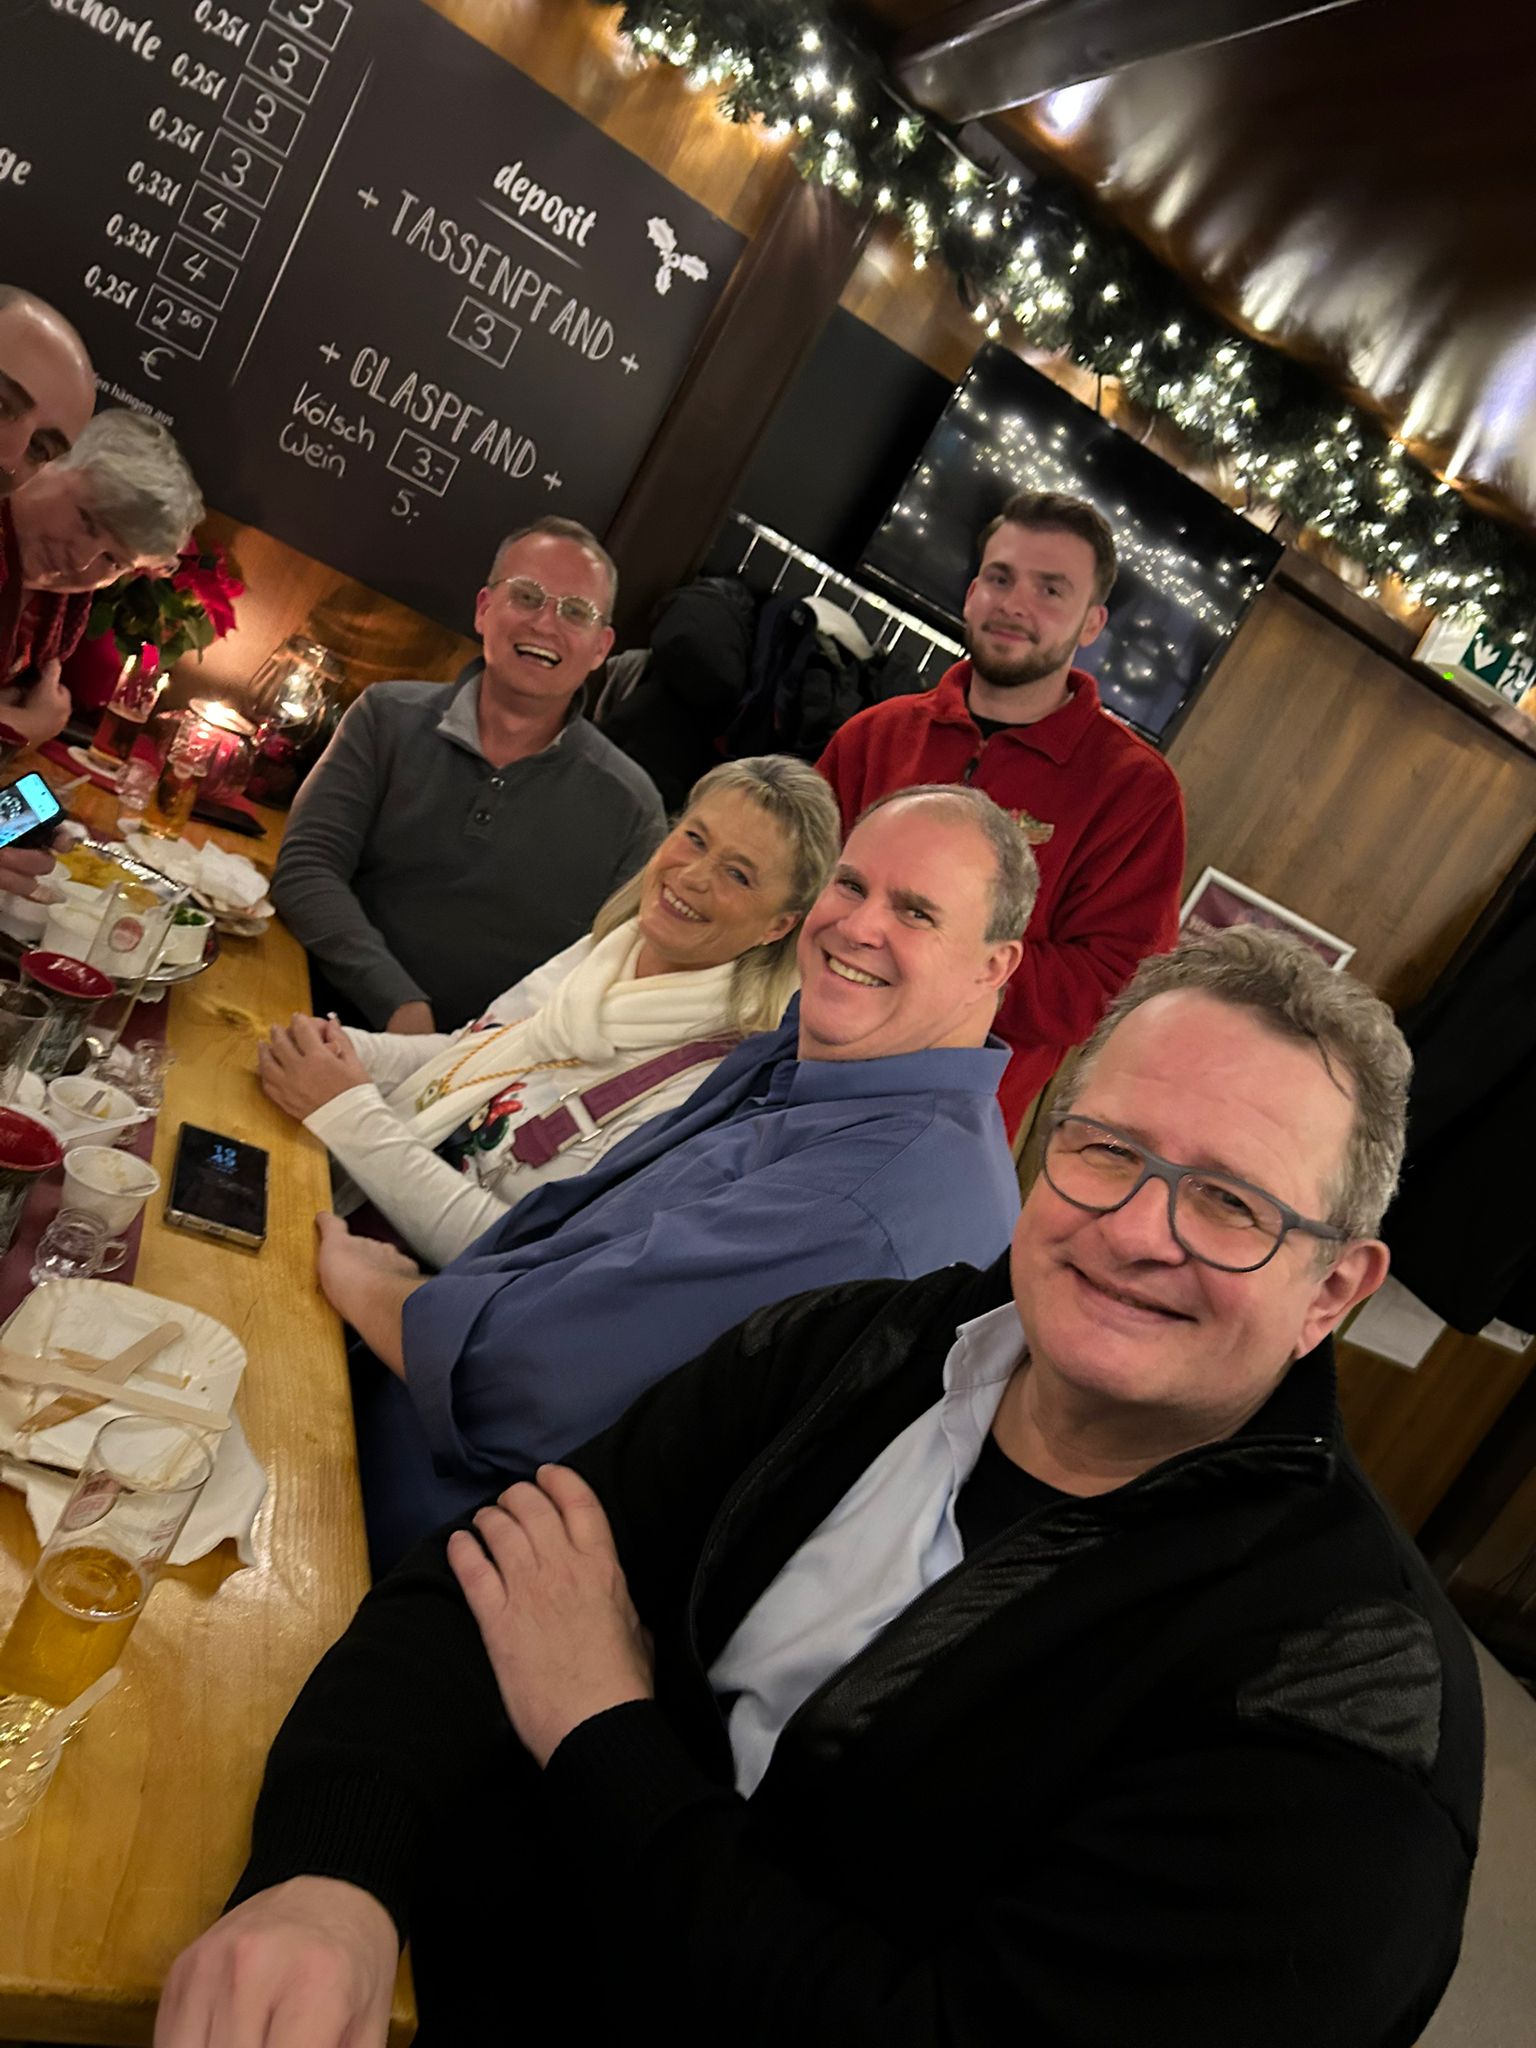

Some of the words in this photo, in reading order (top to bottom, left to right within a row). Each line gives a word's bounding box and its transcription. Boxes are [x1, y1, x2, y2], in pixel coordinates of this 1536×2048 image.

[288, 0, 325, 30] 3
[269, 42, 300, 84] 3
[246, 94, 277, 135] 3
[221, 147, 252, 189] 3
[202, 202, 227, 234] 4
[493, 160, 600, 248] deposit
[182, 253, 207, 283] 4
[467, 311, 496, 350] 3
[292, 381, 376, 452] Kölsch
[279, 423, 347, 478] Wein
